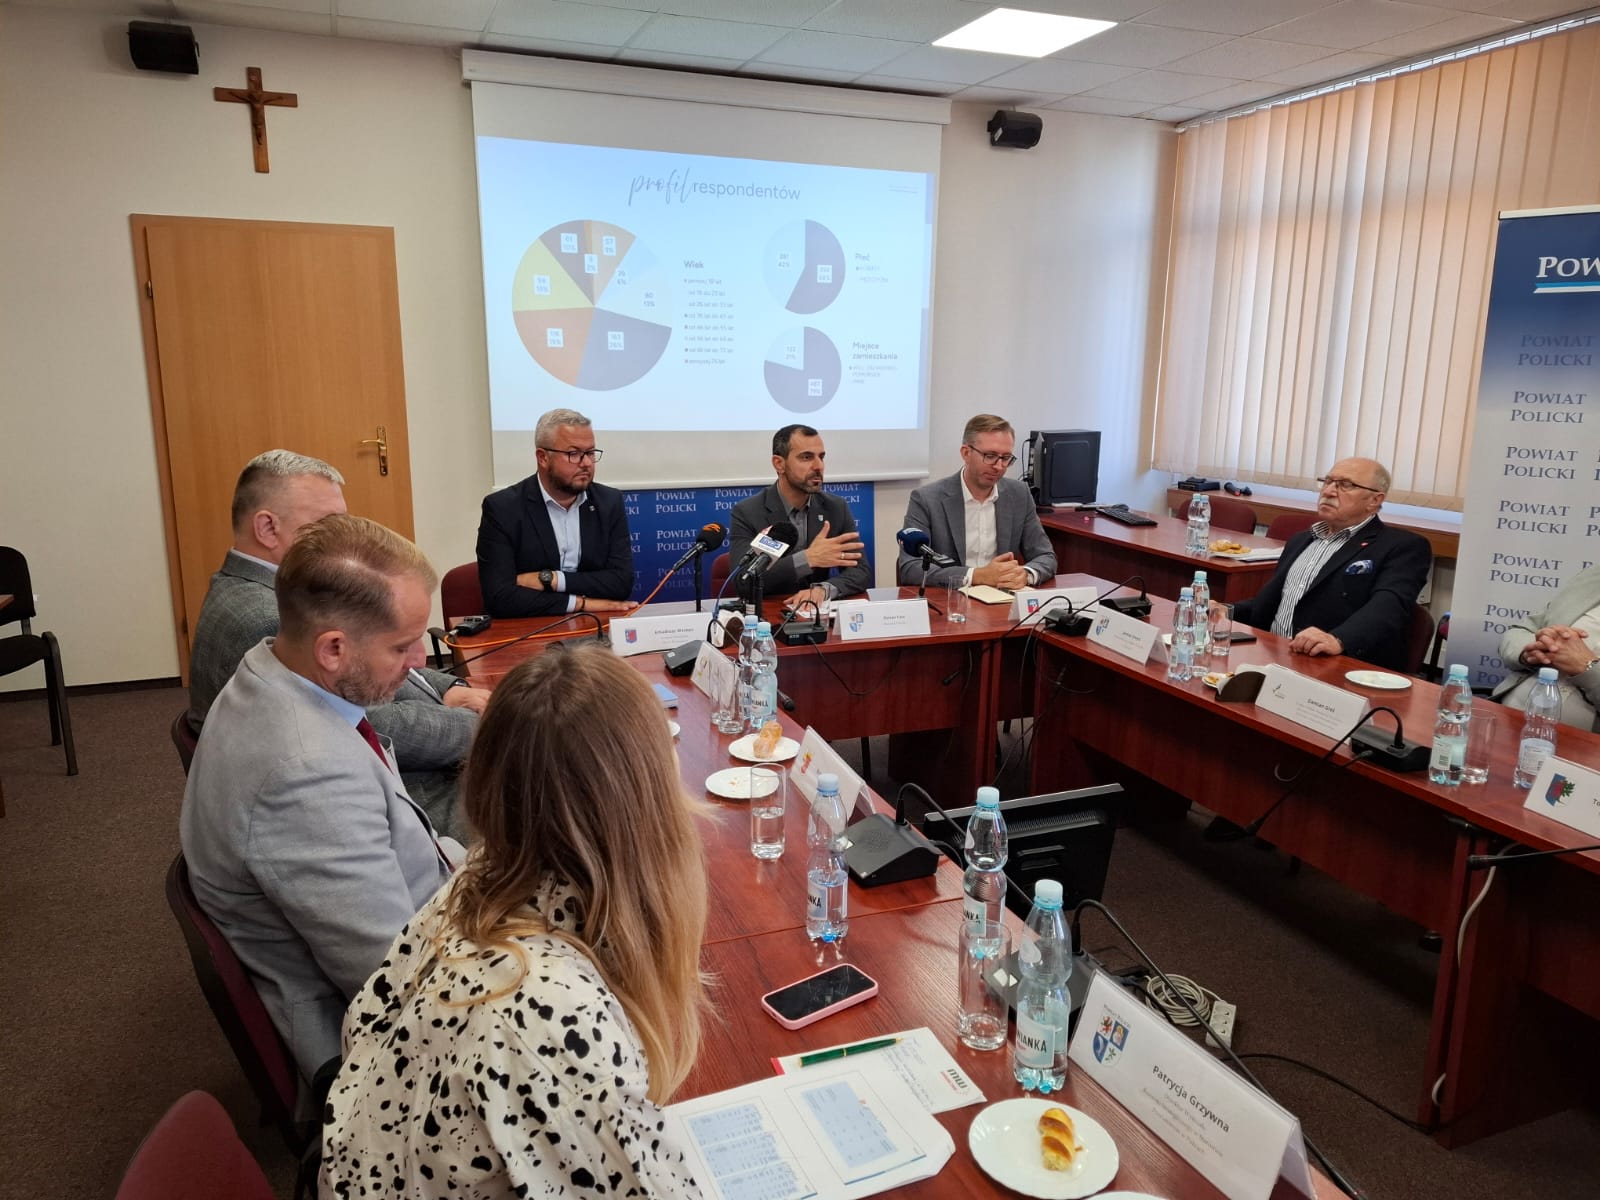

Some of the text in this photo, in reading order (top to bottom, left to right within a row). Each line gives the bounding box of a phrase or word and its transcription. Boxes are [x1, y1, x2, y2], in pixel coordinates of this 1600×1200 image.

[692, 179, 801, 201] respondentów
[1520, 334, 1596, 348] POWIAT
[1517, 353, 1593, 367] POLICKI
[1513, 391, 1587, 405] POWIAT
[1510, 409, 1584, 424] POLICKI
[1506, 446, 1578, 461] POWIAT
[1503, 464, 1576, 480] POLICKI
[715, 488, 754, 498] POWIAT
[823, 483, 860, 492] POWIAT
[655, 491, 696, 501] POWIAT
[655, 503, 697, 514] POLICKI
[1499, 500, 1570, 517] POWIAT
[1496, 517, 1568, 534] POLICKI
[656, 528, 697, 540] POWIAT
[656, 541, 697, 552] POLICK
[1492, 552, 1562, 570] POWIAT
[1490, 569, 1560, 588] POLICKI
[1485, 604, 1530, 620] POW
[1152, 1065, 1188, 1099] Patrycja
[1189, 1095, 1230, 1133] Grzywna
